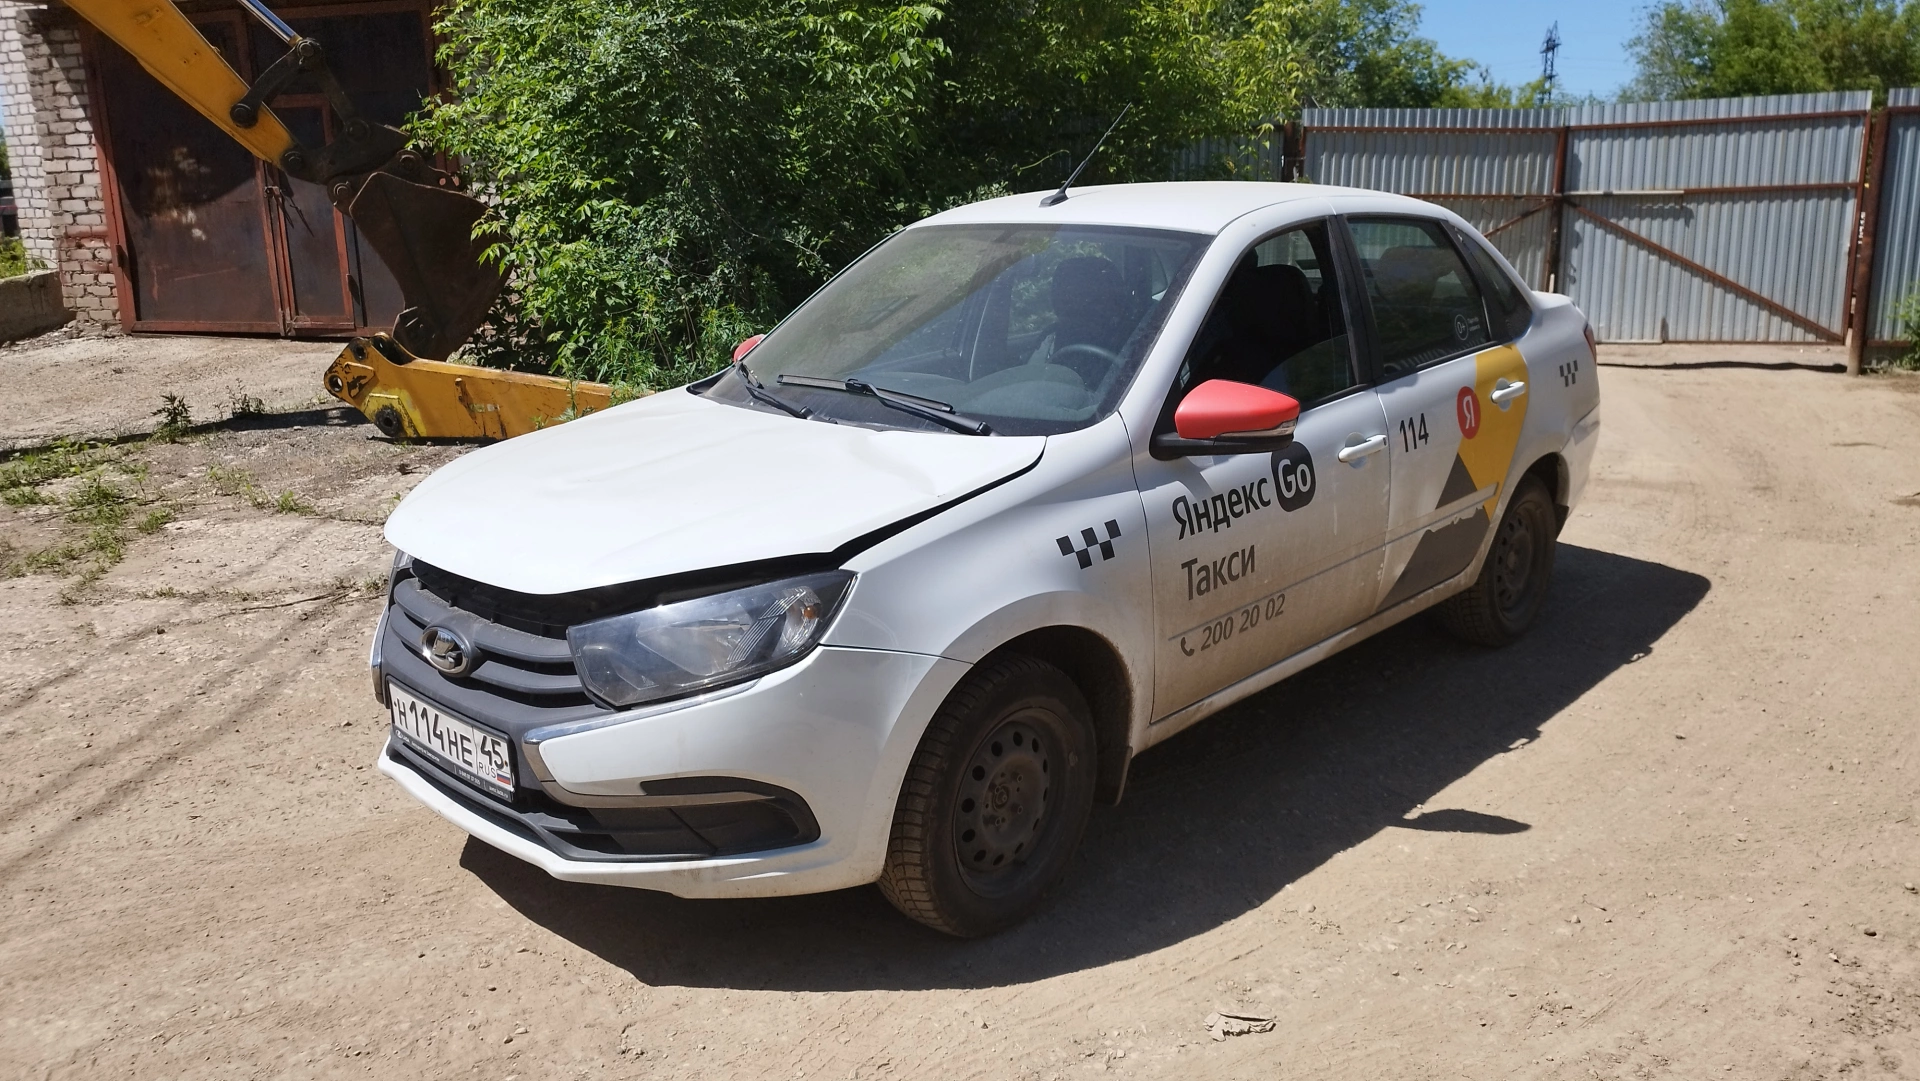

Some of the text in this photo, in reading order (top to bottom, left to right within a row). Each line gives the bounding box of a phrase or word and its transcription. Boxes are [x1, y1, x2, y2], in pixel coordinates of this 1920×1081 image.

[1399, 412, 1429, 453] 114
[1462, 395, 1476, 430] Я
[1172, 458, 1313, 541] Яндекс Go
[1181, 544, 1256, 601] Такси
[1200, 592, 1286, 652] 200 20 02
[478, 761, 497, 779] RUS
[480, 735, 505, 770] 45
